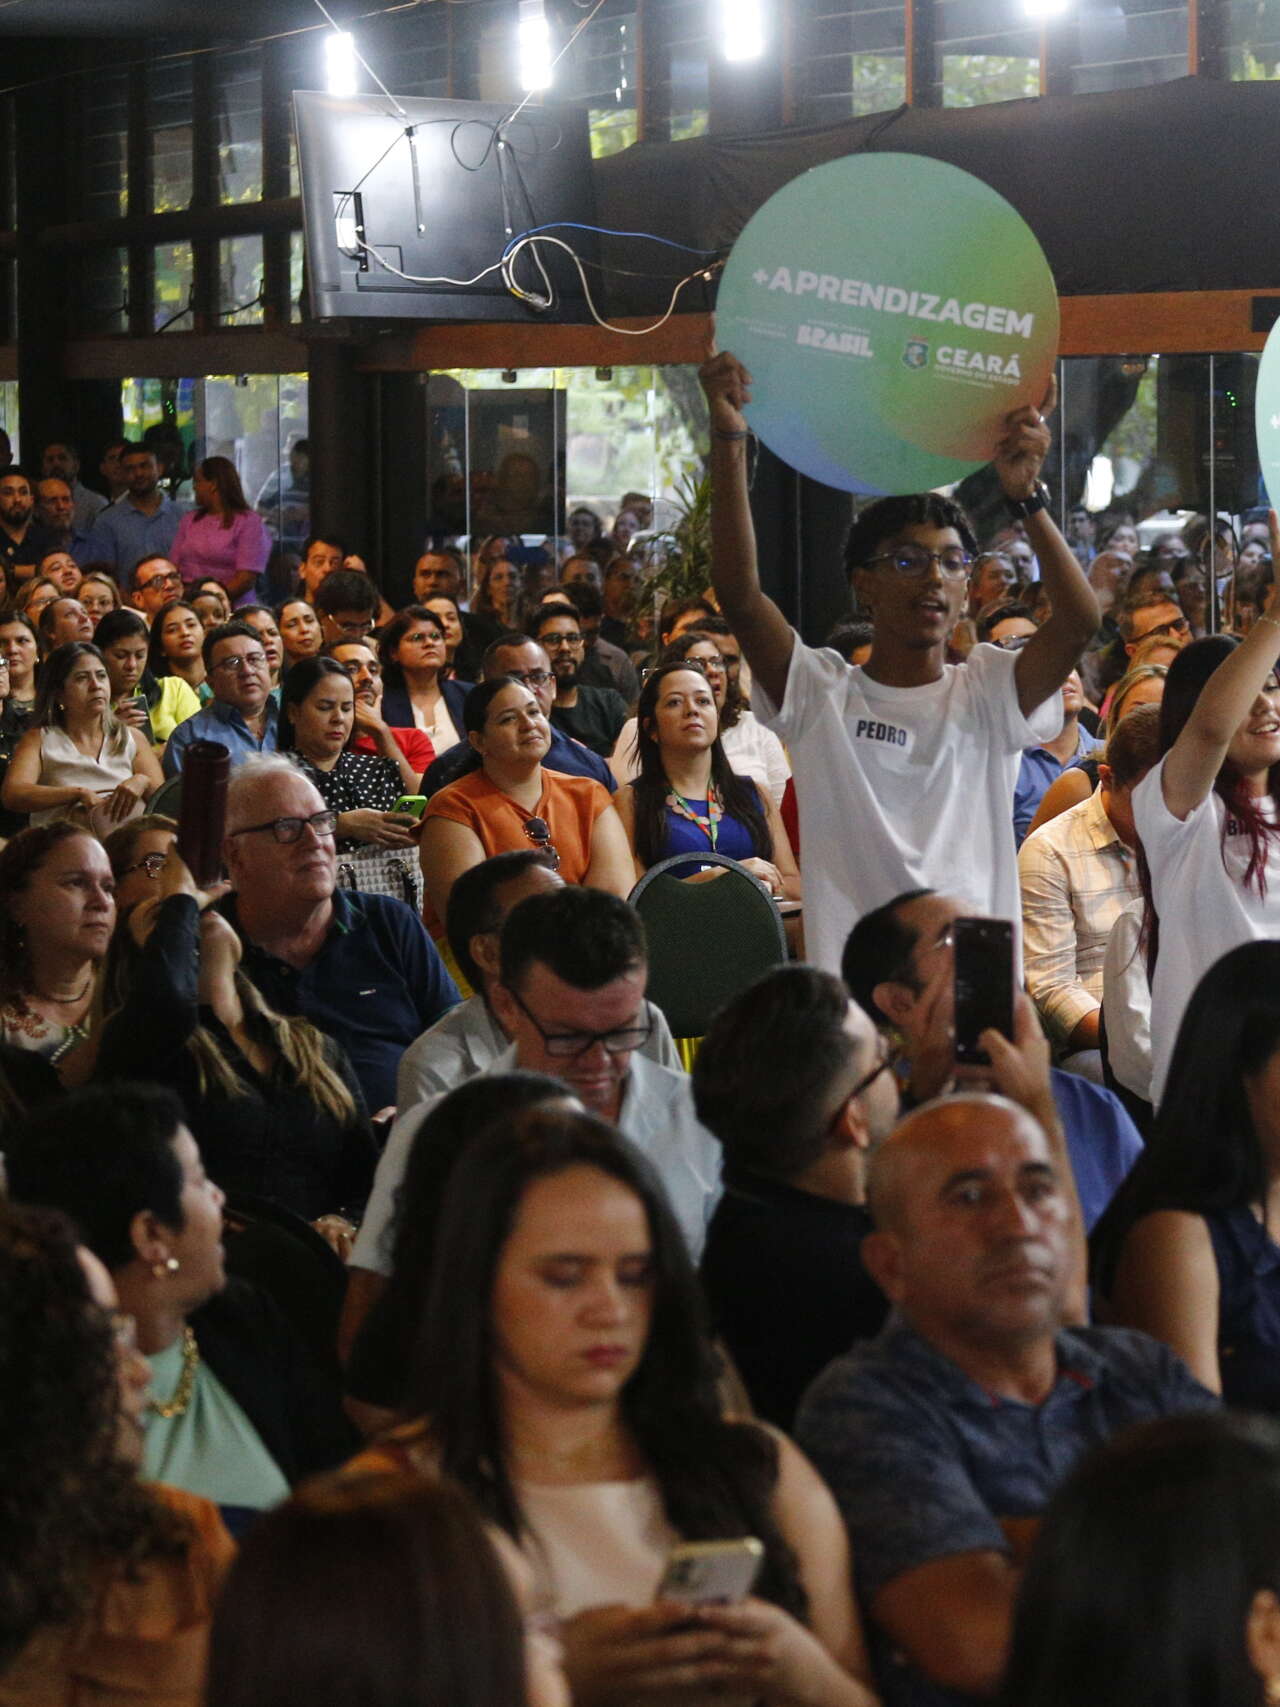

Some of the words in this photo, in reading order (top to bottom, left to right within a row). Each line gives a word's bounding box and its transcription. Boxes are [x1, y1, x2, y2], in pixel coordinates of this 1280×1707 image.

[752, 266, 1035, 338] +APRENDIZAGEM
[796, 324, 874, 358] BRASIL
[936, 345, 1021, 379] CEARÁ
[856, 719, 907, 747] PEDRO
